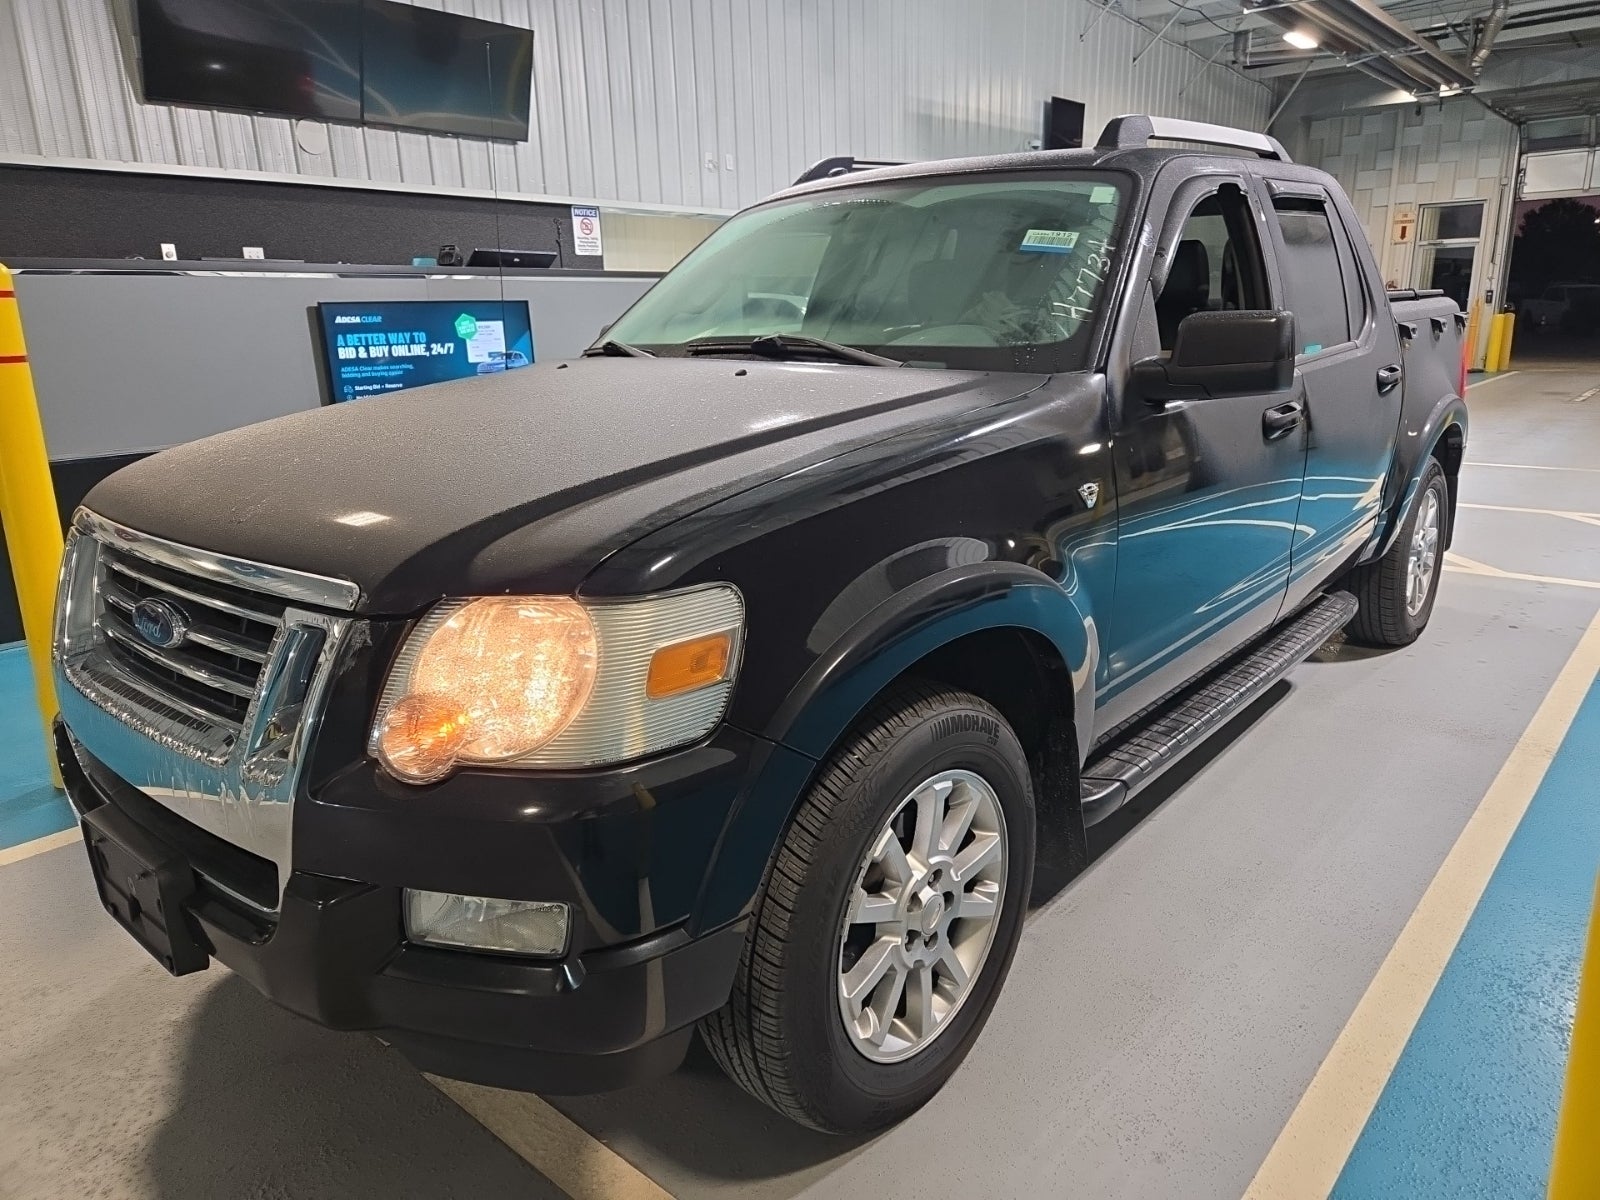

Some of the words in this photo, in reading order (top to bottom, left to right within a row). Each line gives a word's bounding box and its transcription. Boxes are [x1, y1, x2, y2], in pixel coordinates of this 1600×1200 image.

[574, 208, 596, 216] NOTICE
[335, 315, 361, 324] ADESA
[361, 315, 382, 323] CLEAR
[337, 334, 346, 347] A
[346, 333, 386, 346] BETTER
[388, 332, 411, 345] WAY
[413, 332, 426, 343] TO
[338, 347, 357, 360] BID
[358, 346, 368, 358] &
[369, 345, 389, 358] BUY
[391, 344, 430, 357] ONLINE,
[431, 343, 454, 354] 24/7
[950, 714, 1000, 739] MOHAVE
